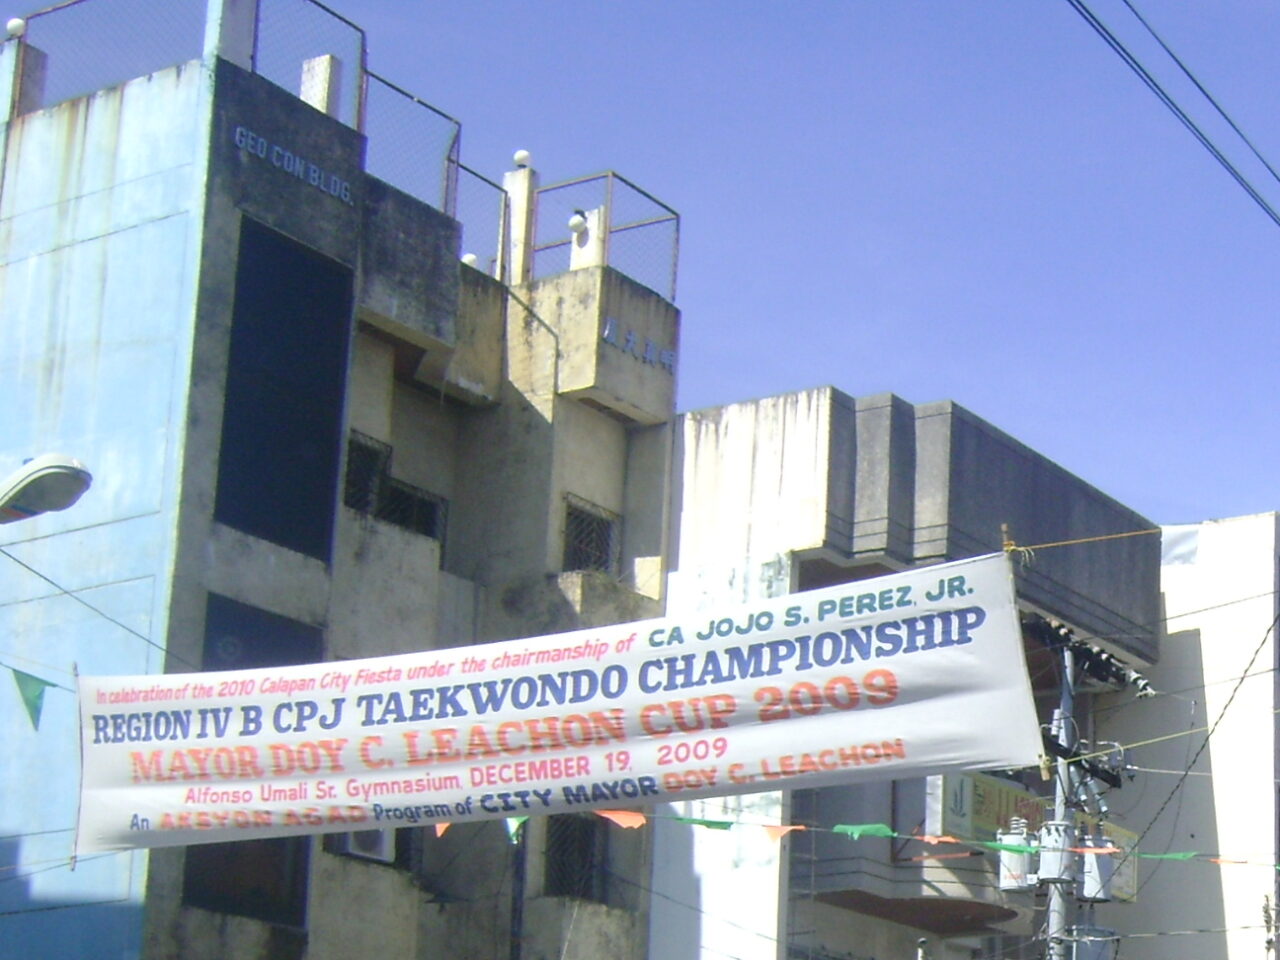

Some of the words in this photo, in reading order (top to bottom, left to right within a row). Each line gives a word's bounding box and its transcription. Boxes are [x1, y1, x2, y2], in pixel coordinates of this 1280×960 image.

[235, 127, 267, 158] GEO
[271, 145, 305, 179] CON
[92, 709, 192, 744] REGION
[196, 706, 233, 739] IV
[239, 704, 264, 736] B
[273, 698, 346, 734] CPJ
[356, 664, 629, 727] TAEKWONDO
[637, 605, 987, 695] CHAMPIONSHIP
[96, 689, 107, 705] In
[108, 684, 173, 704] celebration
[174, 683, 189, 700] of
[192, 683, 214, 699] the
[218, 679, 255, 697] 2010
[259, 676, 316, 698] Calapan
[319, 672, 351, 694] City
[354, 667, 402, 687] Fiesta
[407, 660, 455, 681] under
[461, 656, 486, 674] the
[491, 637, 609, 671] chairmanship
[615, 632, 638, 654] of
[648, 626, 685, 648] CA
[696, 610, 774, 641] JOJO
[783, 606, 810, 628] S.
[817, 585, 918, 621] PEREZ,
[925, 575, 974, 602] JR.
[130, 745, 264, 784] MAYOR
[268, 738, 349, 776] DOY
[359, 735, 394, 769] C.
[402, 708, 628, 767] LEACHON
[638, 693, 738, 739] CUP
[753, 668, 901, 723] 2009
[184, 786, 253, 805] Alfonso
[259, 782, 308, 802] Umali
[315, 780, 338, 800] Sr.
[469, 755, 590, 788] DECEMBER
[656, 736, 729, 766] 2009
[130, 813, 150, 831] An
[159, 809, 273, 831] AKSYON
[282, 804, 368, 827] AGAD
[373, 803, 455, 824] Program
[455, 795, 474, 816] of
[479, 787, 553, 813] CITY
[561, 775, 660, 805] MAYOR
[661, 769, 718, 794] DOY
[727, 762, 755, 785] C.
[760, 738, 906, 780] LEACHON
